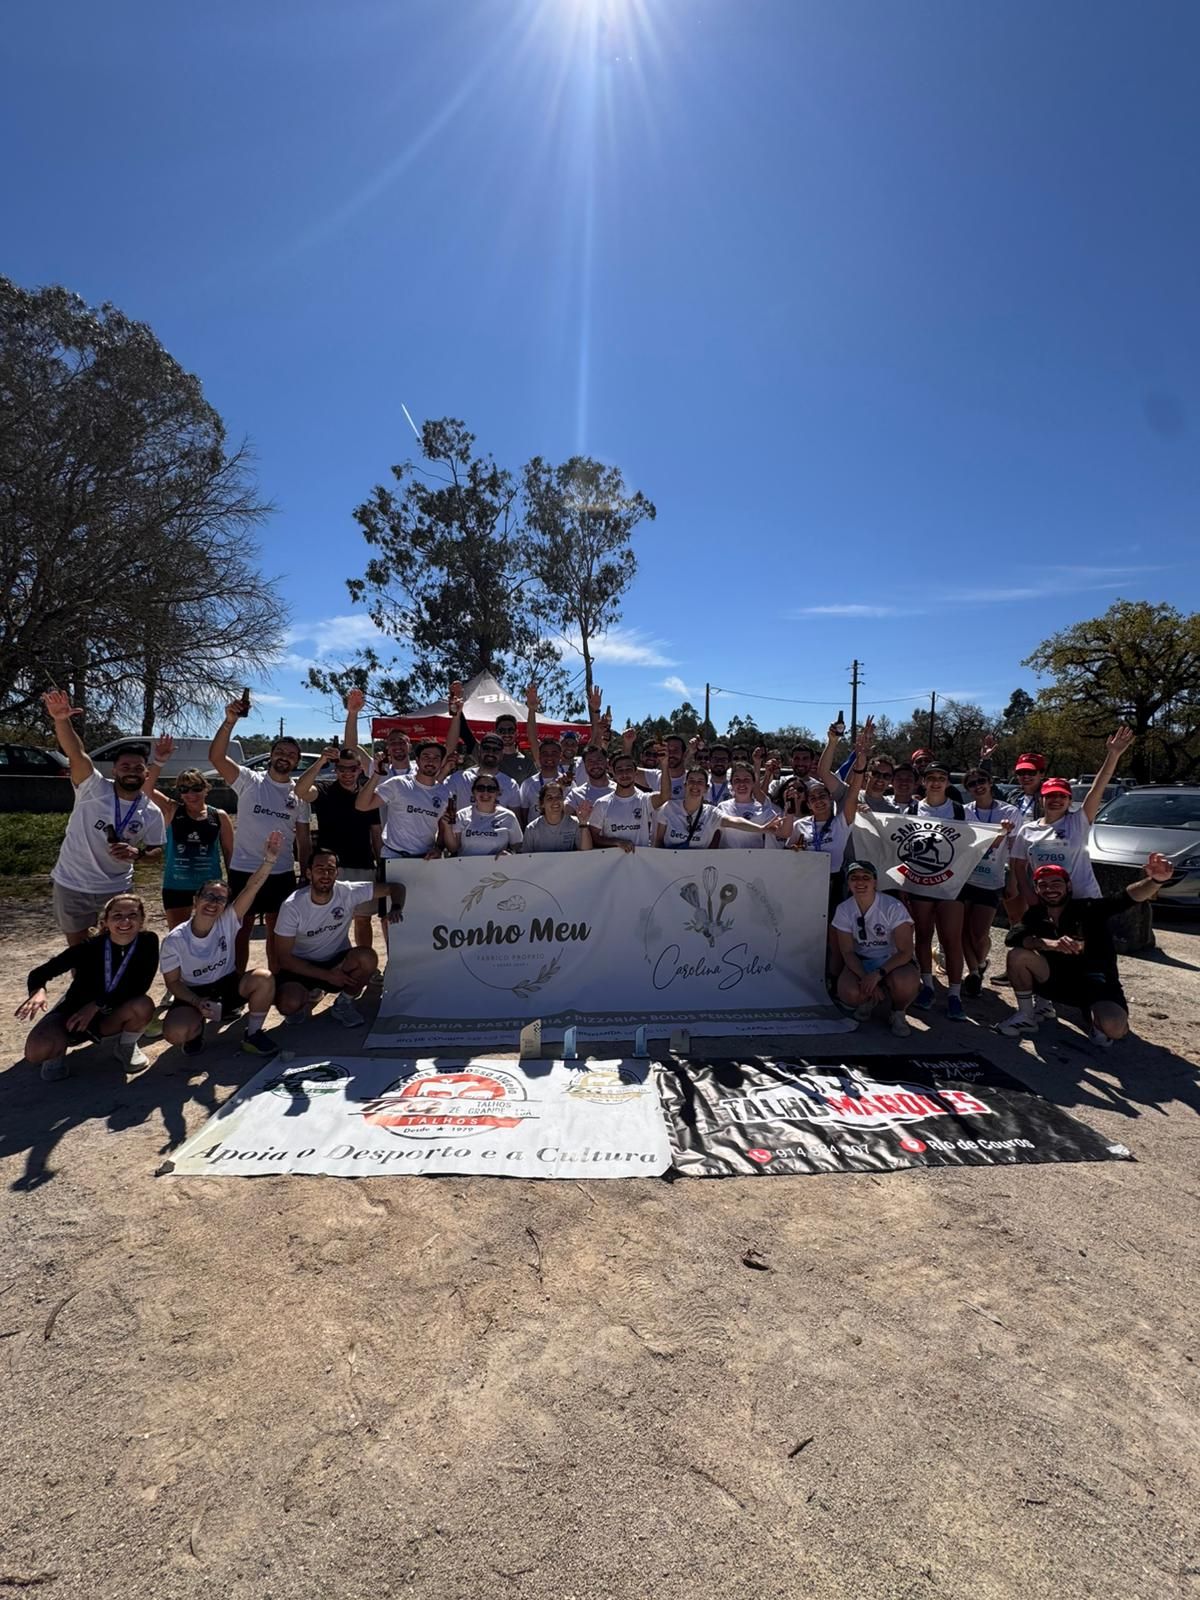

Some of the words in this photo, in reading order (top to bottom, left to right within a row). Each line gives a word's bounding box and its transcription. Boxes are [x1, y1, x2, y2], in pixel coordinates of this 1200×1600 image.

[891, 823, 961, 843] SANDOEIRA
[1037, 853, 1066, 862] 2789
[922, 873, 950, 885] CLUB
[432, 919, 526, 951] Sonho
[529, 917, 592, 944] Meu
[652, 943, 722, 990] Carolina
[718, 942, 774, 991] Silva
[399, 1022, 464, 1032] PADARIA
[406, 1116, 479, 1125] TALHOS
[925, 1138, 957, 1151] Rio
[956, 1138, 979, 1151] de
[976, 1137, 1036, 1150] Couros
[190, 1142, 288, 1165] Apoia
[296, 1147, 316, 1159] o
[323, 1143, 472, 1165] Desporto
[480, 1151, 498, 1160] e
[505, 1151, 524, 1161] a
[536, 1146, 659, 1164] Cultura
[775, 1146, 807, 1159] 914
